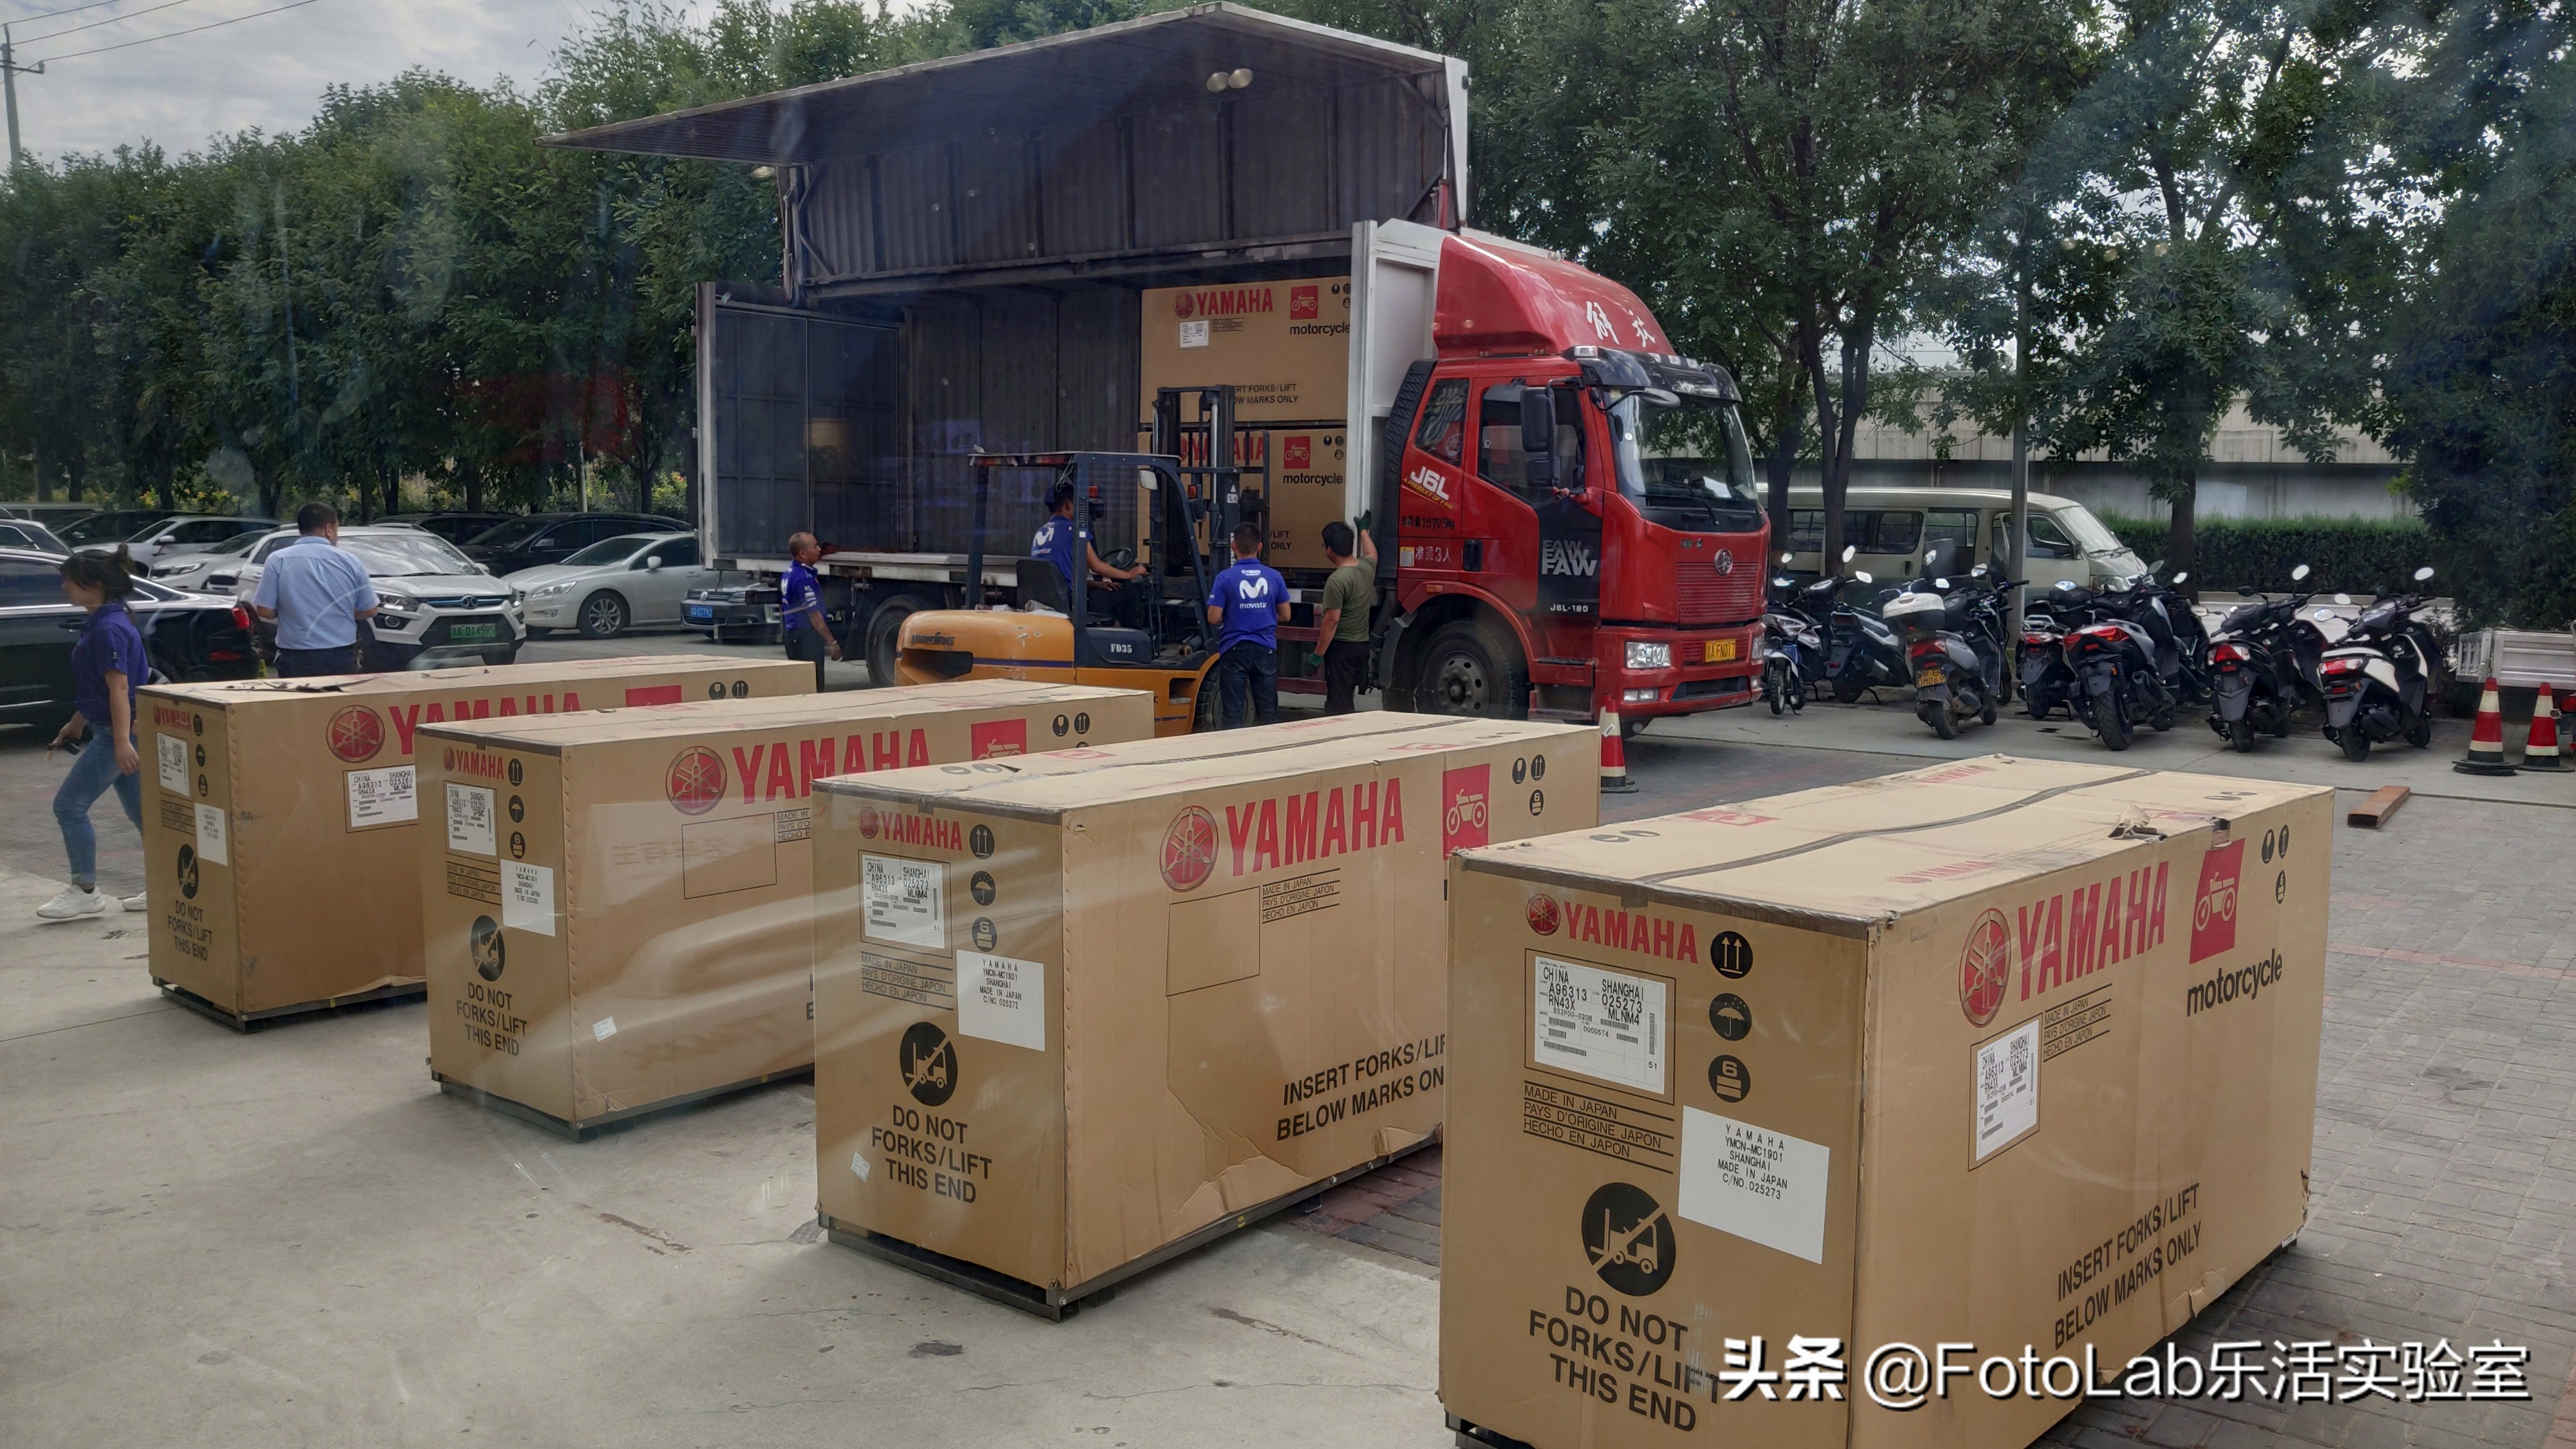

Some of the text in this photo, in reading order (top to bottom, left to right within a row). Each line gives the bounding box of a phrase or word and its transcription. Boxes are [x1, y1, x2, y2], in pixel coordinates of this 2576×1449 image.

[1197, 289, 1273, 316] YAMAHA
[1290, 321, 1350, 336] motorcycle
[1247, 395, 1275, 404] MARKS
[1249, 384, 1297, 392] FORKS/LIFT
[1283, 473, 1343, 486] motorcycle
[1410, 466, 1449, 500] J6L
[1542, 559, 1597, 576] FAW
[1111, 643, 1133, 654] FD35
[456, 749, 504, 780] YAMAHA
[732, 728, 931, 804] YAMAHA
[777, 812, 798, 820] MADE
[778, 822, 794, 831] PAYS
[881, 811, 963, 851] YAMAHA
[1226, 777, 1405, 877] YAMAHA
[778, 831, 802, 841] HECHO
[867, 862, 930, 880] CHINA SHANGHAI
[871, 874, 929, 889] A96313 025272
[907, 889, 928, 899] MLNM4
[1262, 877, 1311, 896] MADE IN JAPAN
[1262, 884, 1334, 909] PAYS D'ORIGINE JAPON
[175, 900, 204, 923] DO NOT
[1262, 899, 1318, 921] HECHO EN JAPON
[167, 915, 213, 945] FORKS/LIFT
[1564, 901, 1698, 964] YAMAHA
[2018, 860, 2169, 1002] YAMAHA
[174, 935, 208, 961] THIS END
[862, 954, 918, 975] MADE IN JAPAN
[862, 967, 946, 994] PAYS D'ORIGINE JAPON
[862, 980, 927, 1003] HECHO EN JAPON
[980, 985, 1022, 1001] MADE IN JAPAN
[987, 978, 1011, 989] SHANGHAI
[1544, 967, 1643, 1001] CHINA SHANGHAI
[2187, 948, 2282, 1017] motorcycle
[468, 982, 513, 1010] DO NOT
[1549, 982, 1642, 1014] A96313 025273
[1549, 994, 1640, 1026] RN43X MLNM4
[2045, 997, 2088, 1025] MADE IN JAPAN
[456, 999, 527, 1037] FORKS/LIFT
[1583, 1026, 1609, 1037] 0000574
[2045, 1005, 2106, 1042] PAYS D'ORIGINE JAPON
[465, 1023, 519, 1056] THIS END
[2043, 1027, 2092, 1058] HECHO EN JAPON
[1283, 1033, 1446, 1106] INSERT FORKS/LIF
[1648, 1061, 1658, 1070] 51
[1277, 1065, 1444, 1141] BELOW MARKS ON
[1524, 1085, 1617, 1120] MADE IN JAPAN
[893, 1104, 968, 1144] DO NOT
[1524, 1102, 1662, 1149] PAYS D'ORIGINE JAPON
[1524, 1117, 1630, 1158] HECHO EN JAPON
[871, 1126, 992, 1179] FORKS/LIFT
[1725, 1137, 1783, 1162] YMCN-MC1901
[1730, 1150, 1770, 1171] SHANGHAI
[885, 1157, 929, 1191] THIS
[934, 1172, 976, 1204] END
[1718, 1159, 1788, 1189] MADE IN JAPAN
[2058, 1182, 2199, 1302] INSERT FORKS/LIFT
[2054, 1221, 2202, 1350] BELOW MARKS ONLY
[1566, 1286, 1688, 1352] DO NOT
[1529, 1309, 1725, 1404] FORKS/LIFT
[1549, 1352, 1696, 1432] THIS END
